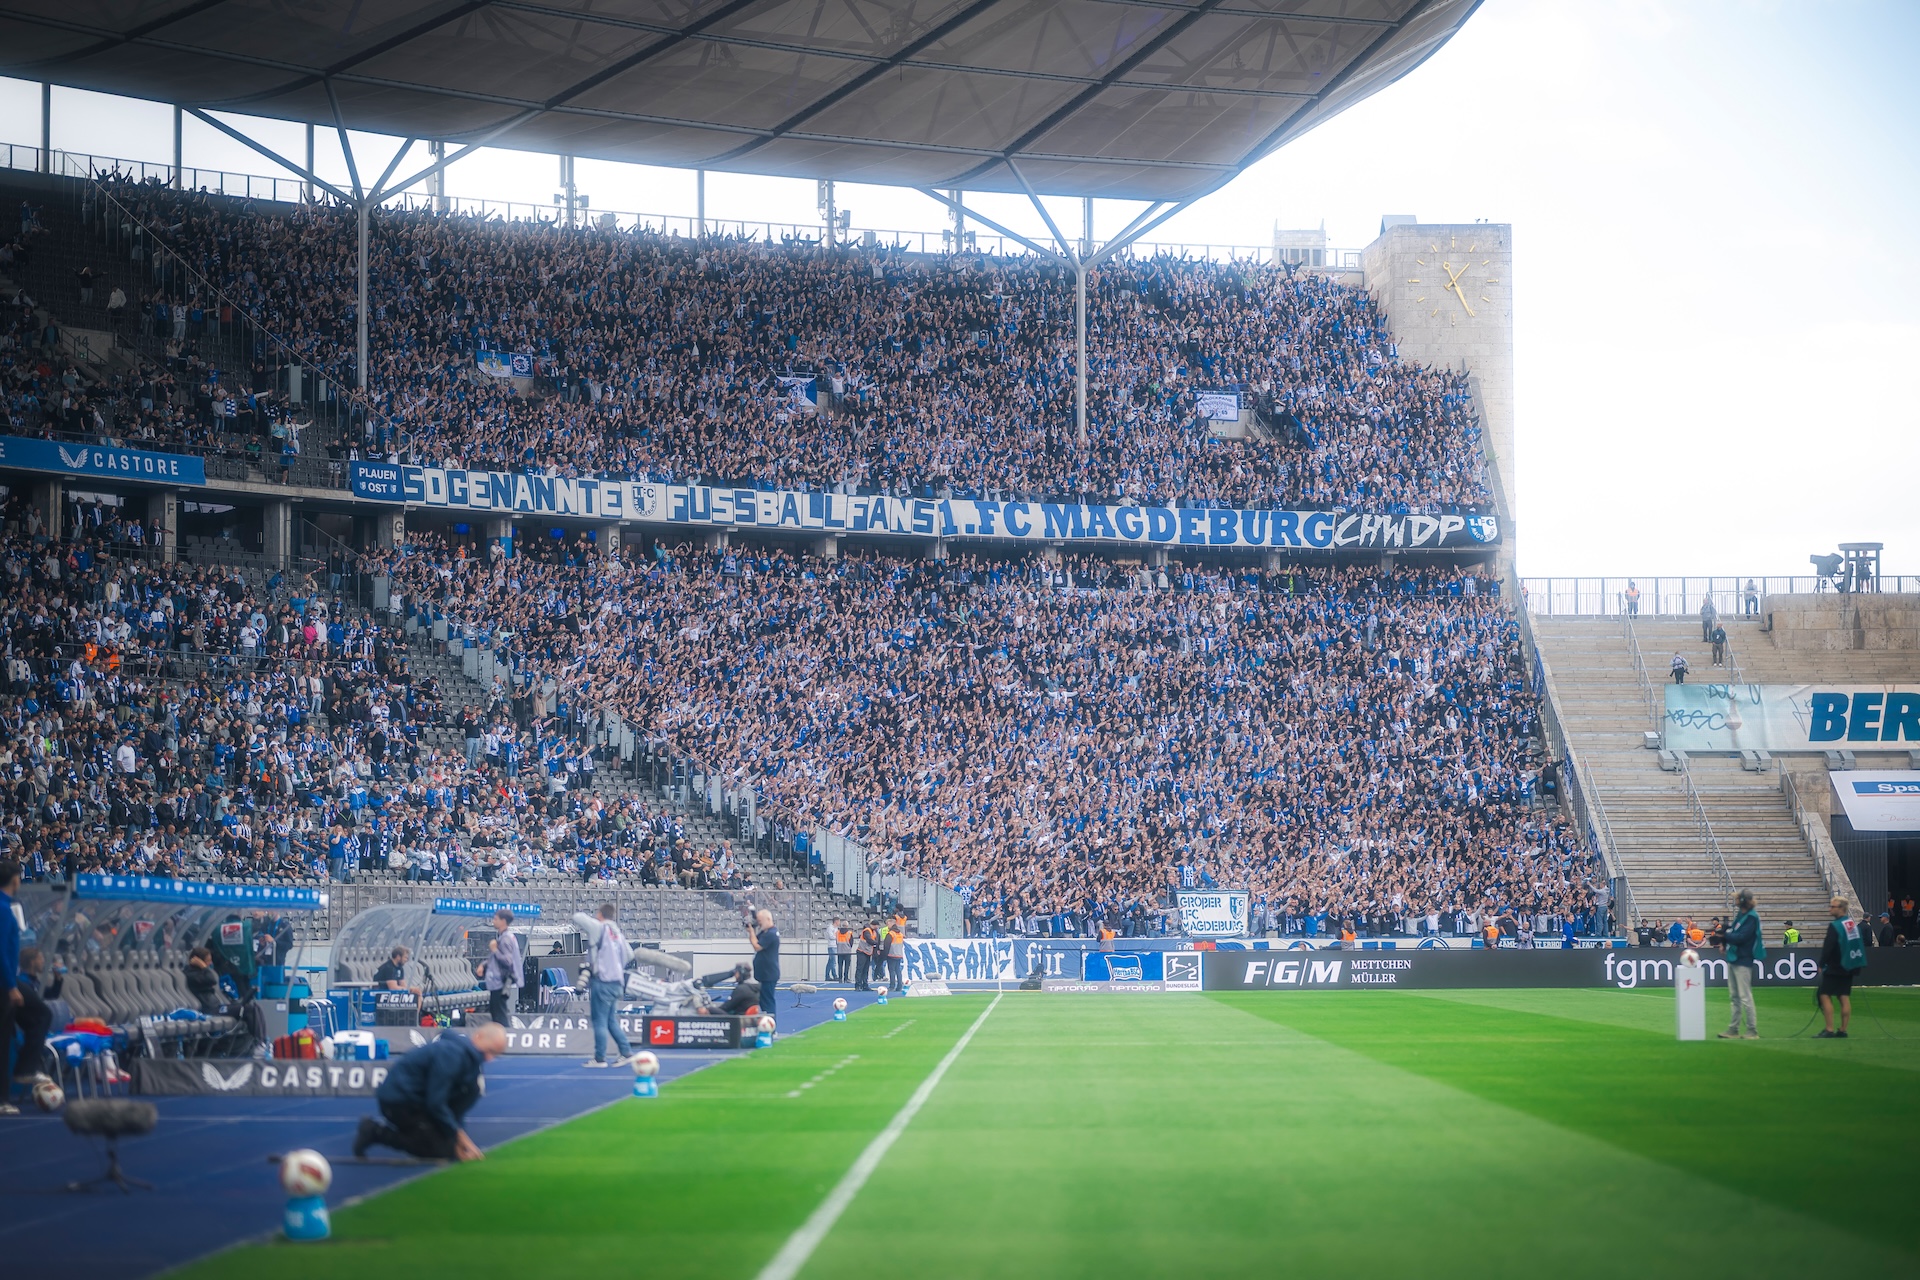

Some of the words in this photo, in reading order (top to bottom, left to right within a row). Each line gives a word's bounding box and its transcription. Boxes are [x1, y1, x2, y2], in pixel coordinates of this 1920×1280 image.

[93, 452, 179, 475] CASTORE
[358, 467, 397, 480] PLAUEN
[368, 482, 387, 493] OST
[403, 465, 622, 518] SOGENANNTE
[669, 486, 936, 534] FUSSBALLFANS
[168, 503, 174, 515] F
[394, 521, 403, 533] G
[1042, 502, 1335, 548] MAGDEBURG
[1335, 512, 1466, 547] CHWDP
[610, 535, 619, 547] G
[1808, 692, 1920, 742] BER
[1877, 783, 1920, 793] Spa
[1182, 920, 1244, 932] MAGDEBURG
[1849, 949, 1863, 959] 04
[1351, 959, 1412, 970] METTCHEN
[1188, 968, 1197, 979] 2
[1351, 973, 1397, 983] MÜLLER
[678, 1021, 692, 1029] DIE
[691, 1021, 731, 1030] OFFIZIELLE
